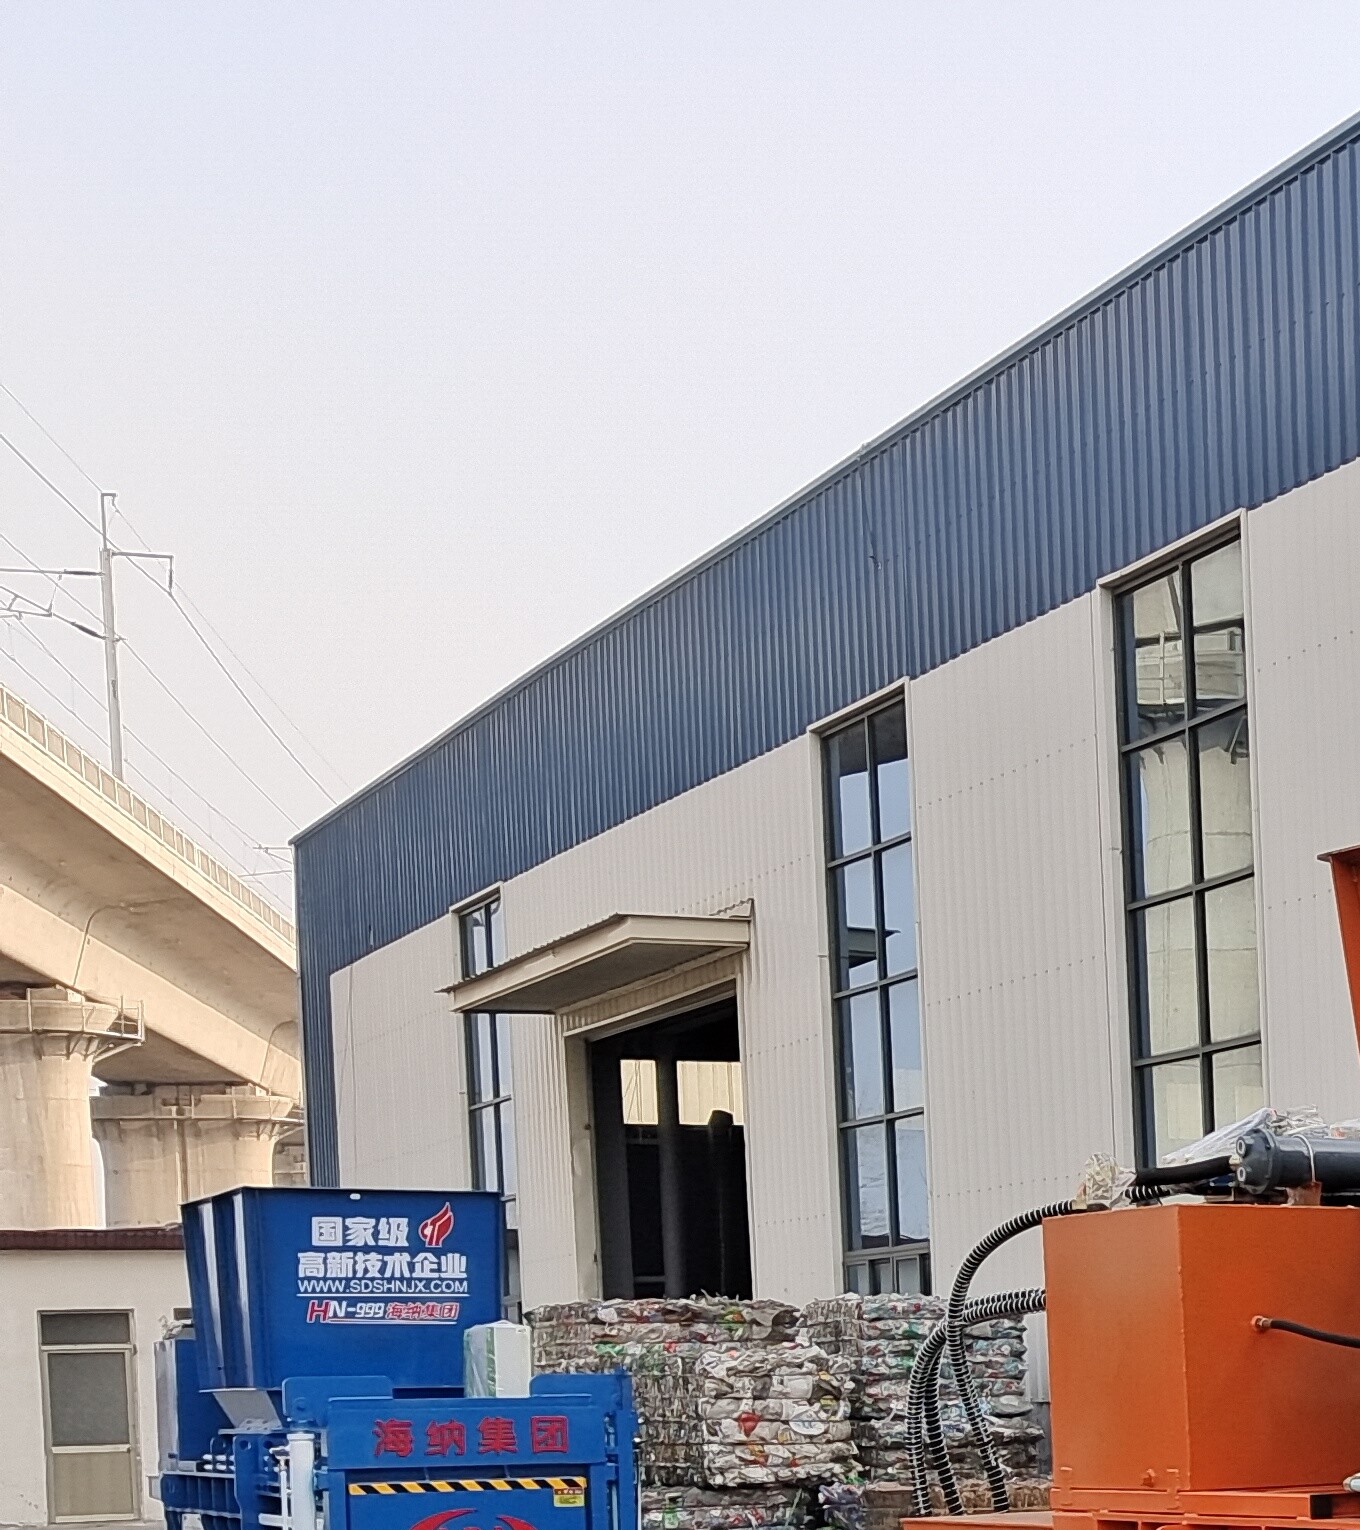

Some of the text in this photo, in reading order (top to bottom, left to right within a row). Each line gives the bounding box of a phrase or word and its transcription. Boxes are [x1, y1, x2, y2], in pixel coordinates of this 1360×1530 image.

[311, 1216, 409, 1247] 国家级
[297, 1251, 468, 1278] 高新技术企业
[297, 1279, 468, 1293] WWW.SDSHNJX.COM
[373, 1415, 570, 1459] 海纳集团
